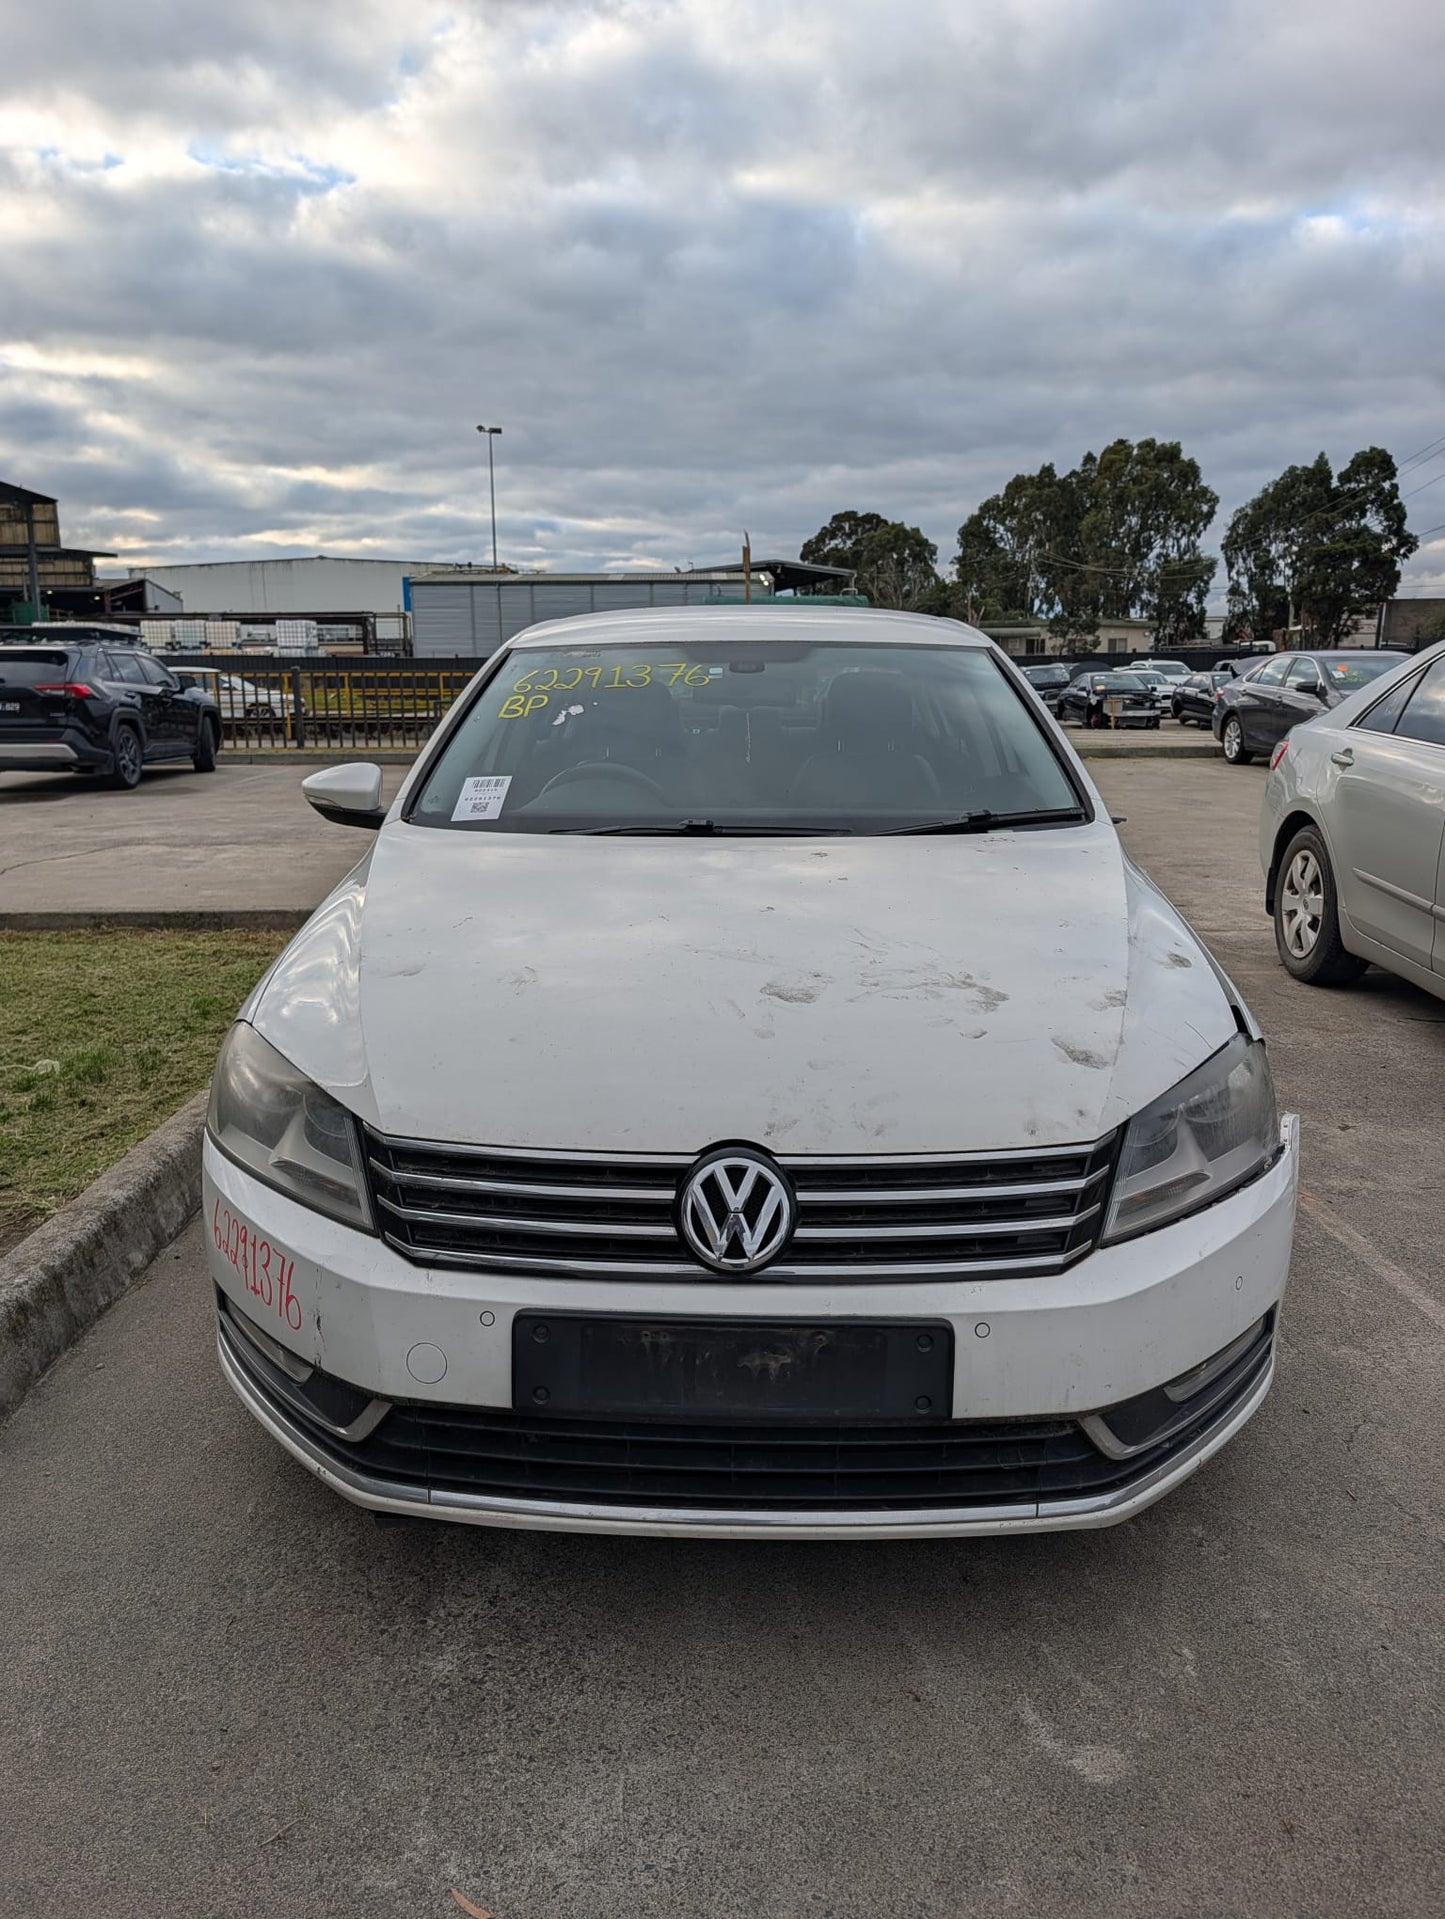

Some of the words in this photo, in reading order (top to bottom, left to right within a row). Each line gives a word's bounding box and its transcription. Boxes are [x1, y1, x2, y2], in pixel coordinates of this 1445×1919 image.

[512, 663, 711, 693] 62291376
[498, 694, 549, 719] BP
[213, 1199, 302, 1331] 62291376
